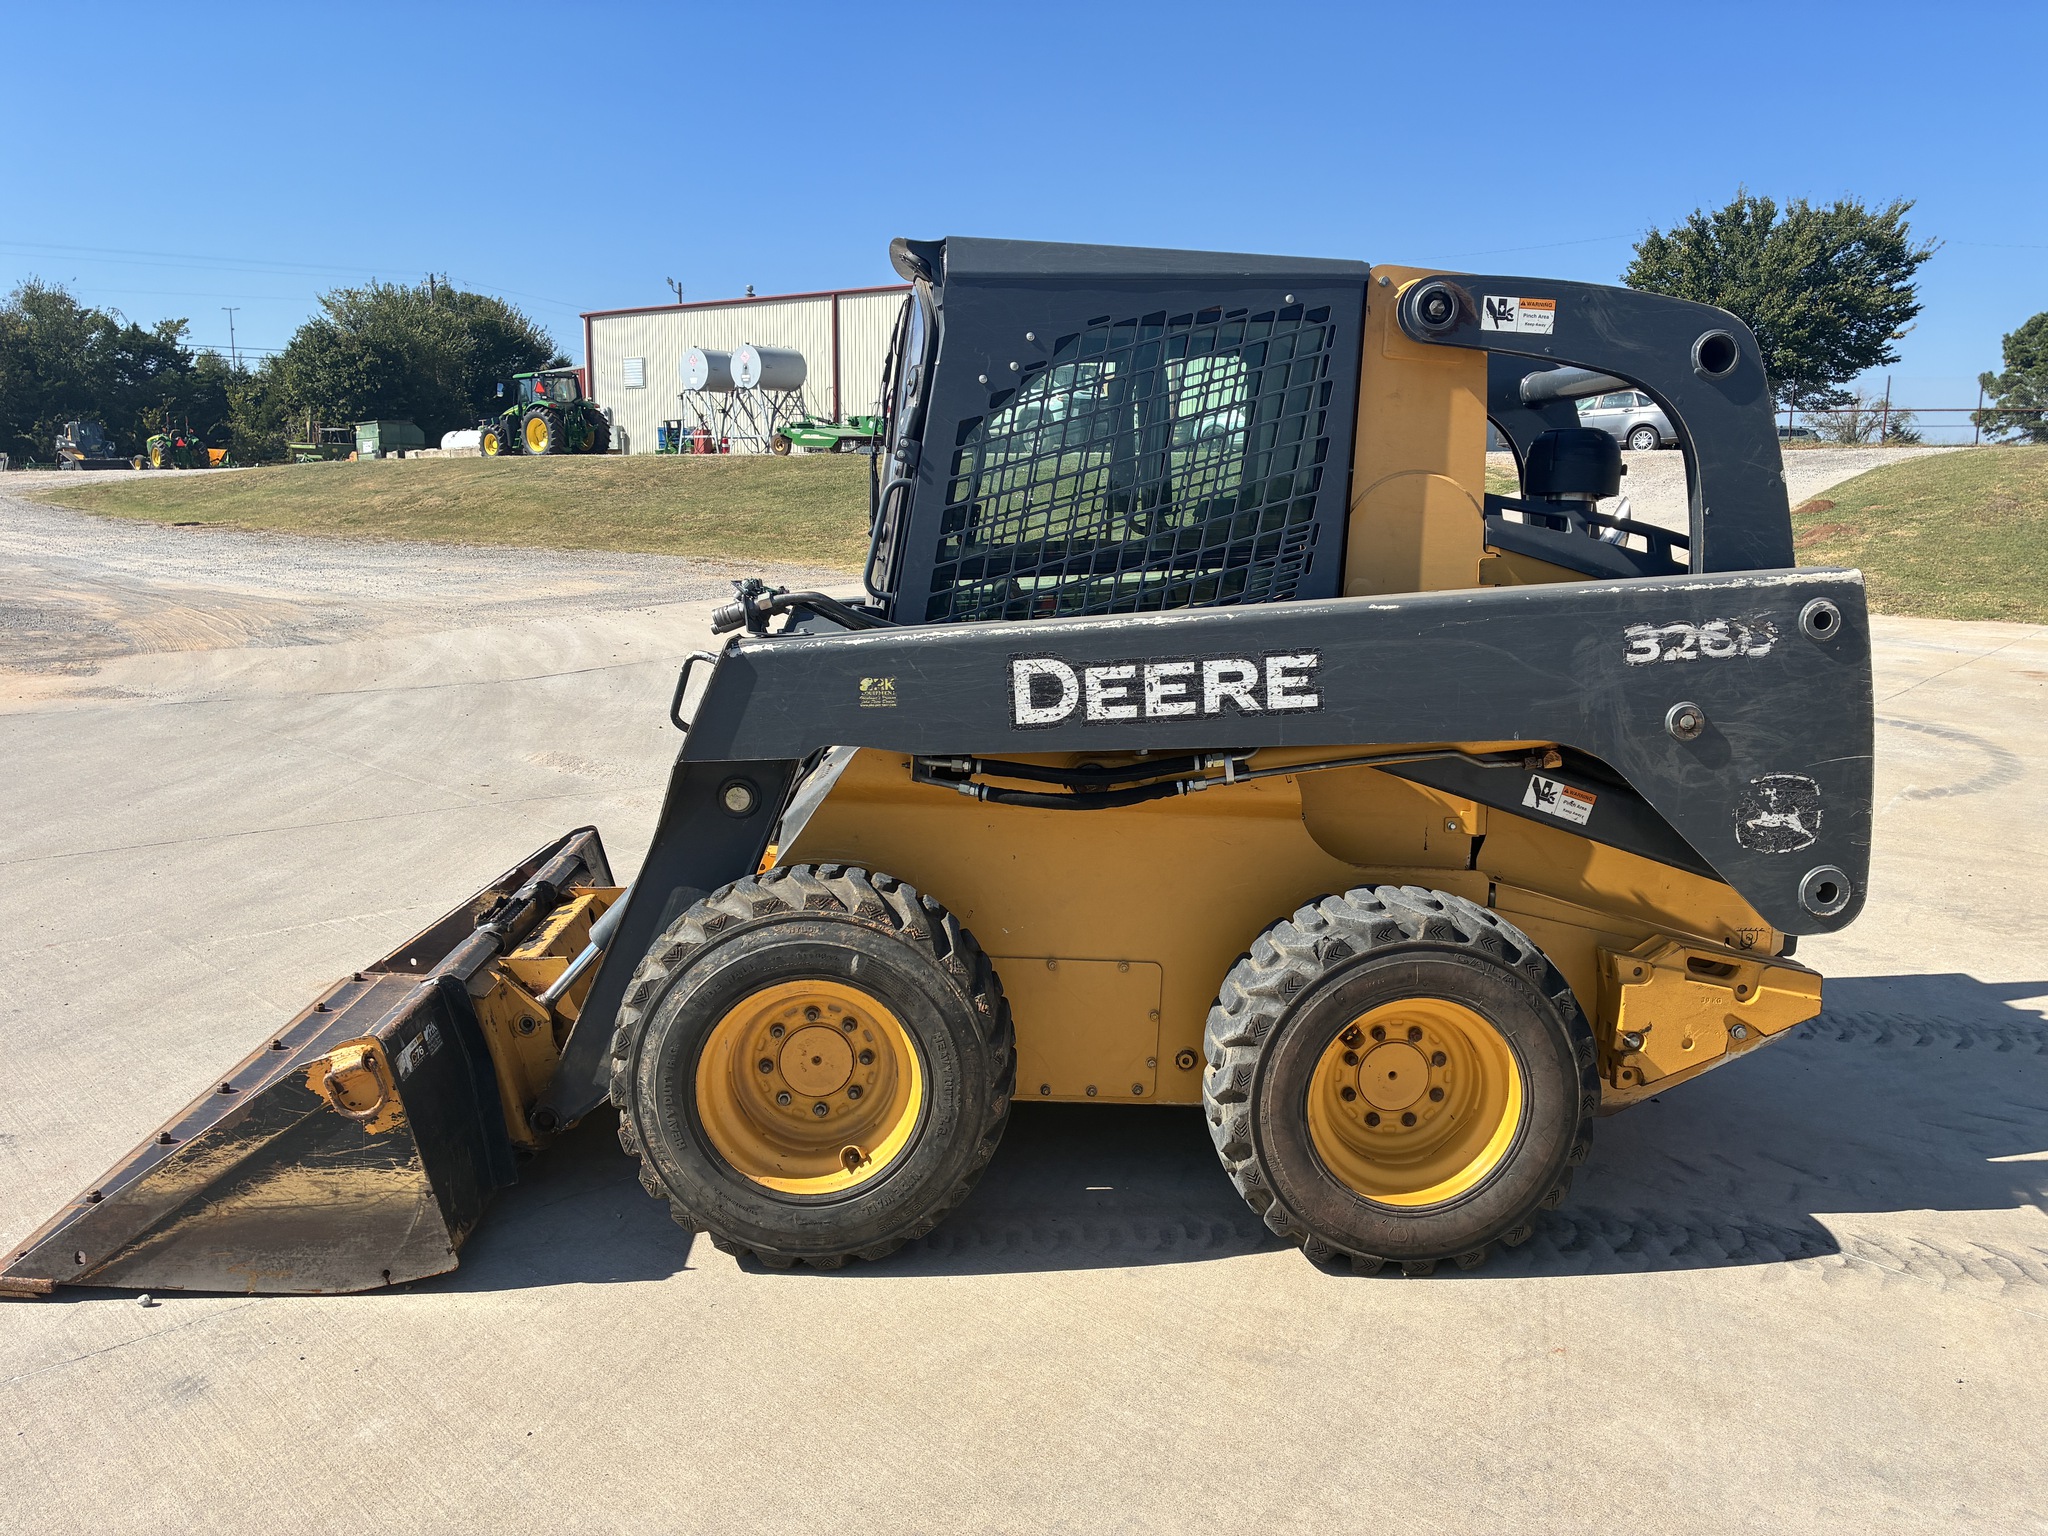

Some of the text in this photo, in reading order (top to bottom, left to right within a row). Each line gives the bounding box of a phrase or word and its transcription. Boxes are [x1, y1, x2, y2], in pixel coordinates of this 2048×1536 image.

[1013, 654, 1319, 725] DEERE
[1569, 790, 1593, 802] WARNING
[933, 1032, 953, 1074] HEAVY
[664, 1106, 688, 1151] HEAVY
